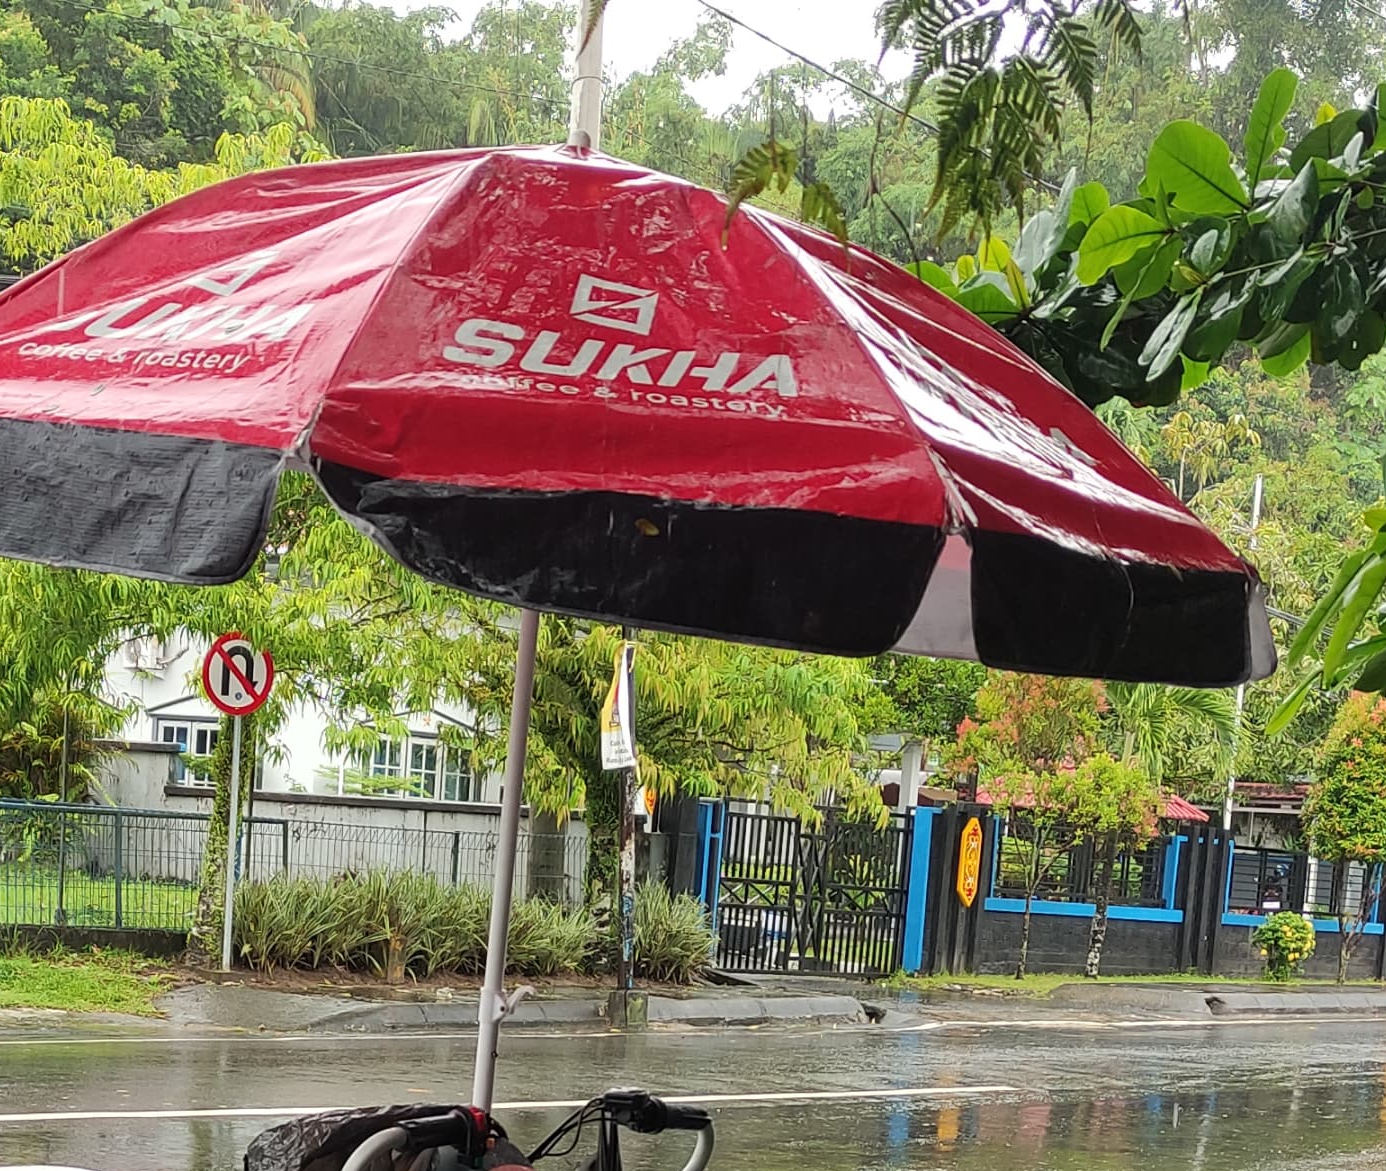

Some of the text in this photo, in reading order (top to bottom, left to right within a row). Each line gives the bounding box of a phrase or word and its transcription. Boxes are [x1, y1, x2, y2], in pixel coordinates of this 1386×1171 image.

[17, 341, 252, 374] coffee & roastery
[442, 318, 799, 398] SUKHA
[459, 372, 786, 419] coffee & roastery
